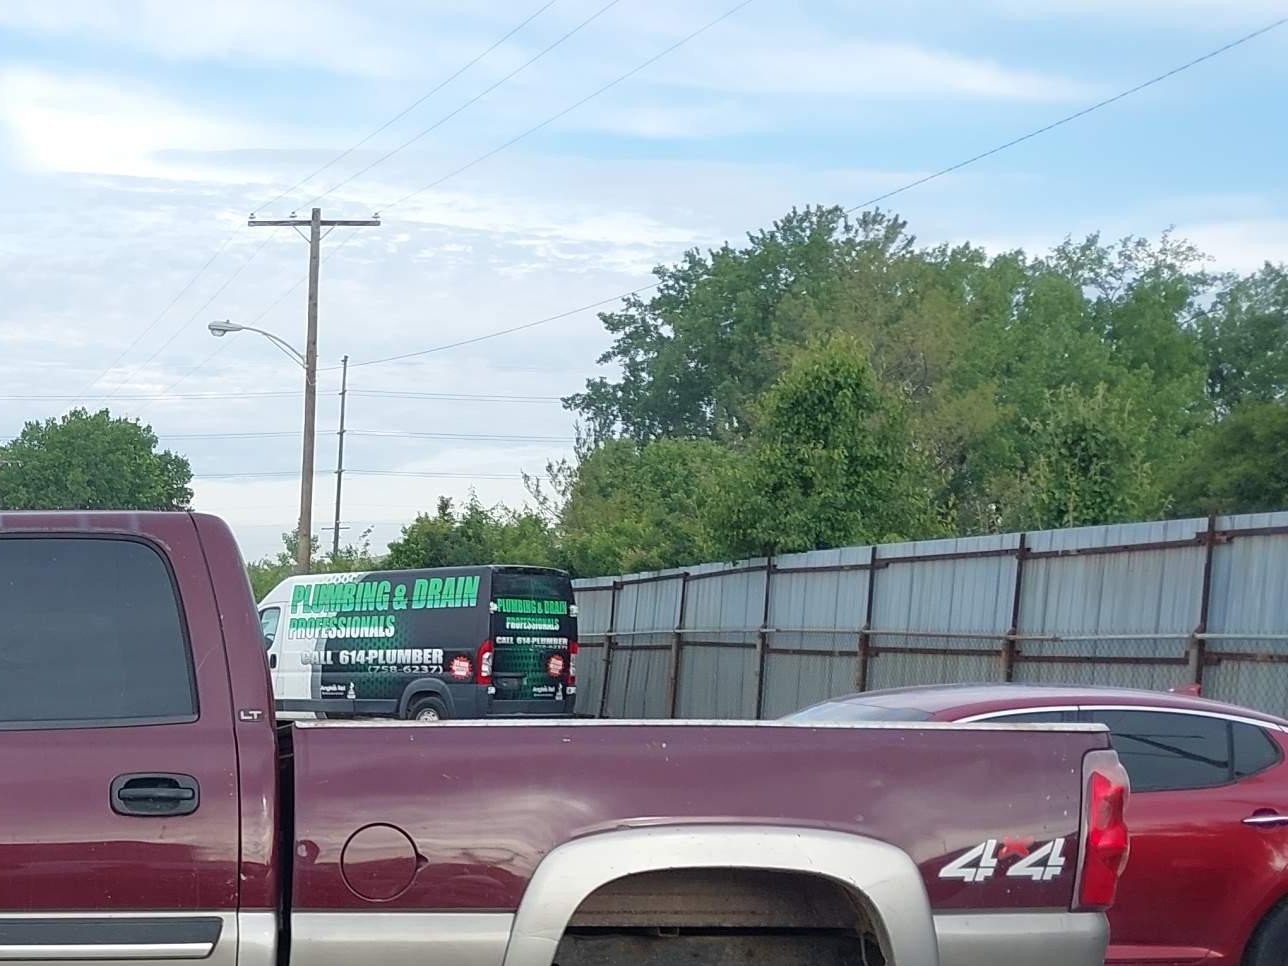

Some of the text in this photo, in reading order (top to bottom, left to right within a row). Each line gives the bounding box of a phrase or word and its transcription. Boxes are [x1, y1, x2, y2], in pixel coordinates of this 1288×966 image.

[291, 576, 480, 614] PLUMBING & DRAIN
[288, 616, 395, 639] PROFESSIONALS
[301, 649, 444, 665] CALL 614-PLUMBER
[240, 710, 262, 720] LT
